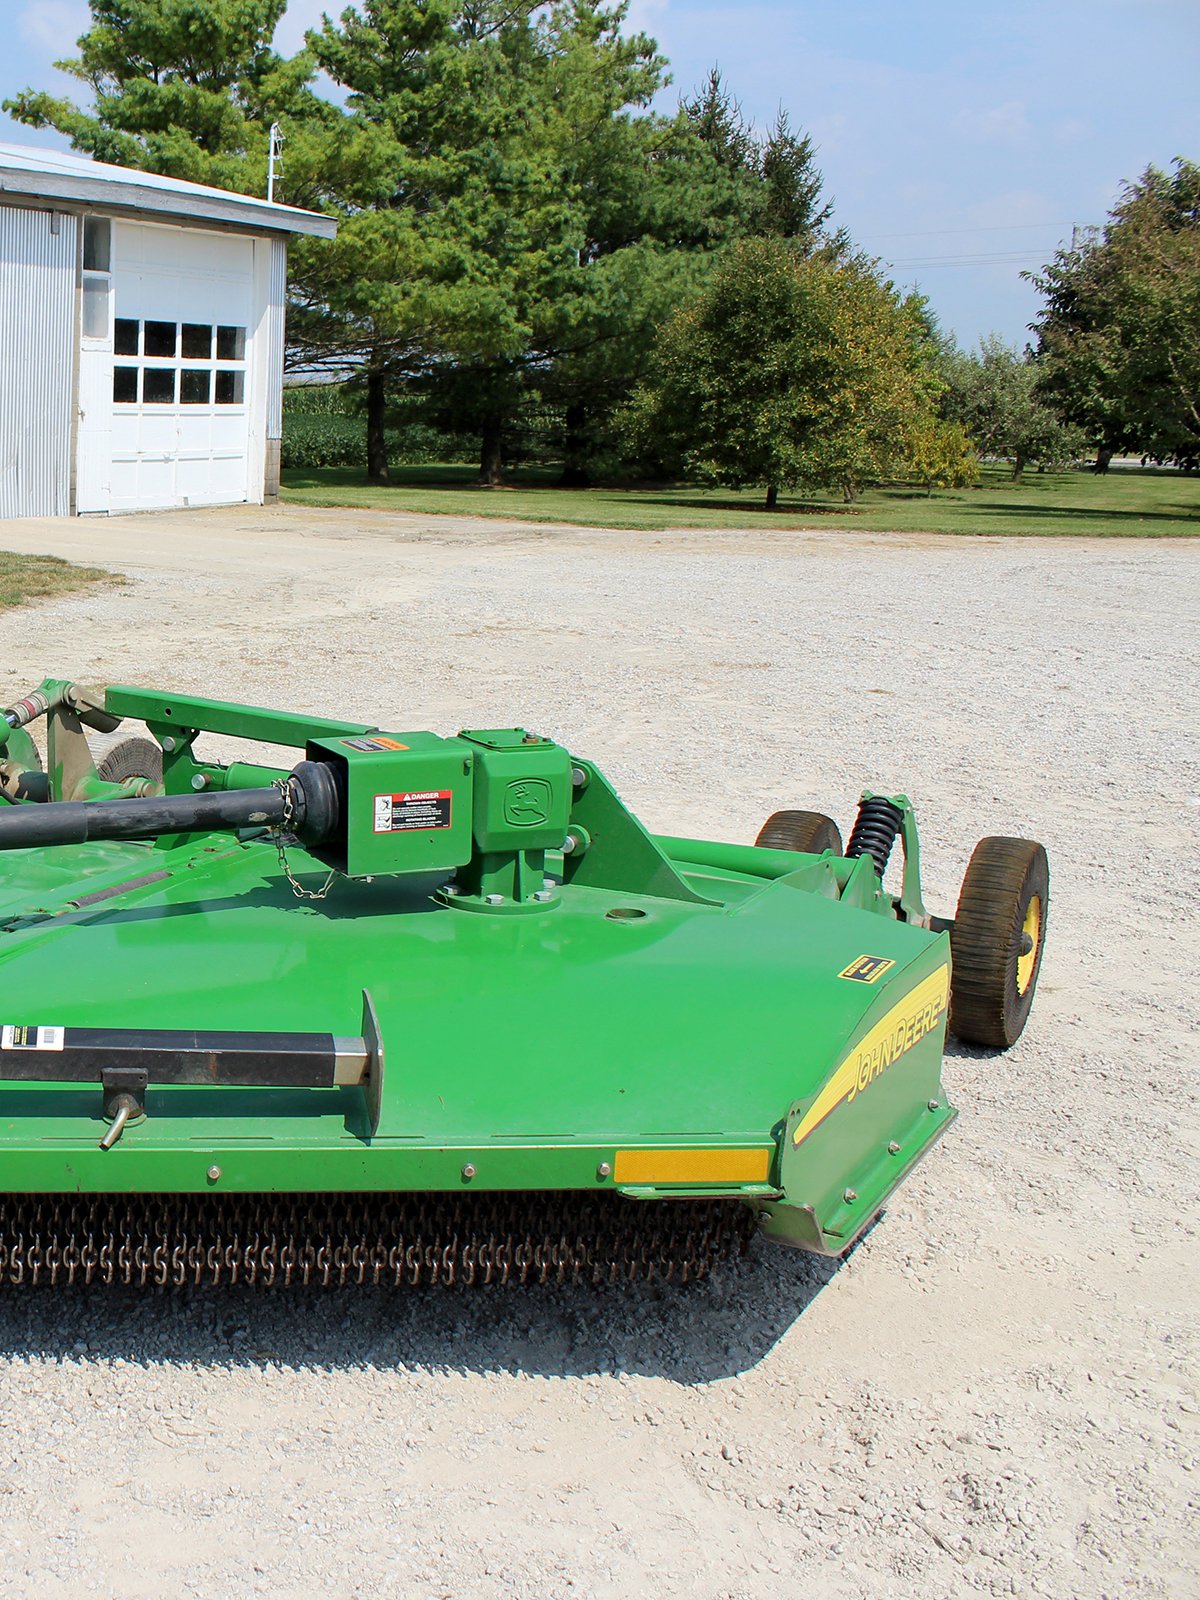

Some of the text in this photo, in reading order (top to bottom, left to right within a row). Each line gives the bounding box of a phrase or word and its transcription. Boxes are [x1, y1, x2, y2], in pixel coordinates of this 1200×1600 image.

[411, 792, 439, 800] DANGER
[847, 996, 942, 1103] JOHN DEERE
